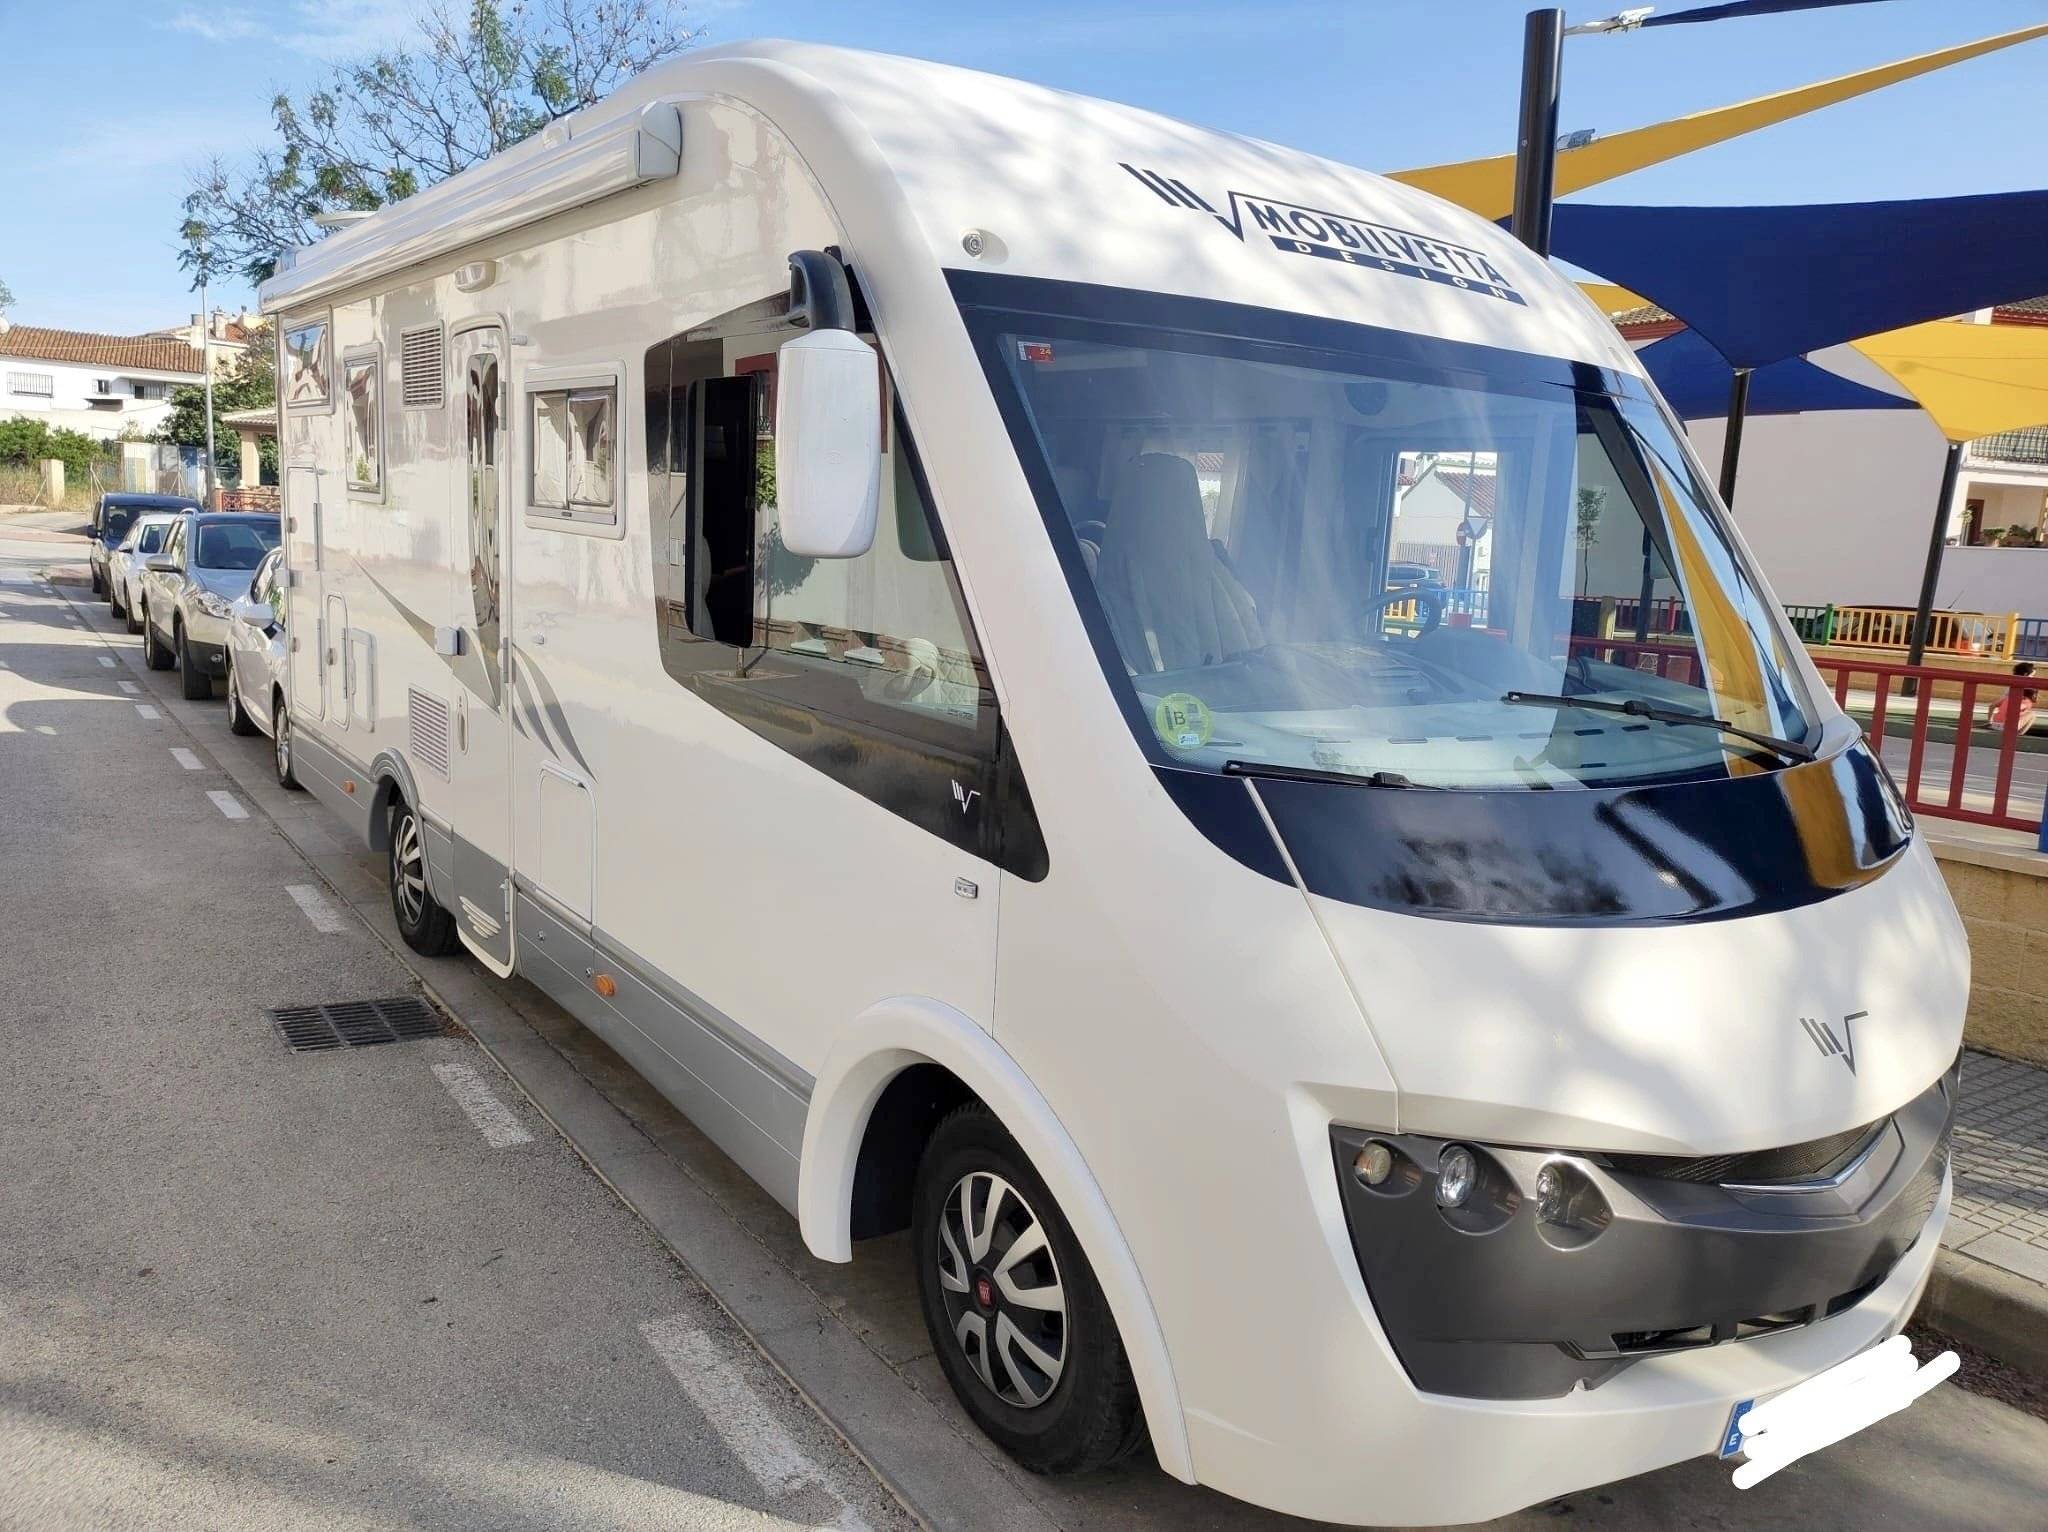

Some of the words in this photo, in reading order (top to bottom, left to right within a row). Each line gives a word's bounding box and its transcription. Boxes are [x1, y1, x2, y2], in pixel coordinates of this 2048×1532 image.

[1244, 200, 1511, 287] MOBILVETTA
[1294, 241, 1508, 299] DESIGN
[1173, 711, 1186, 726] B
[1728, 1432, 1740, 1447] E
